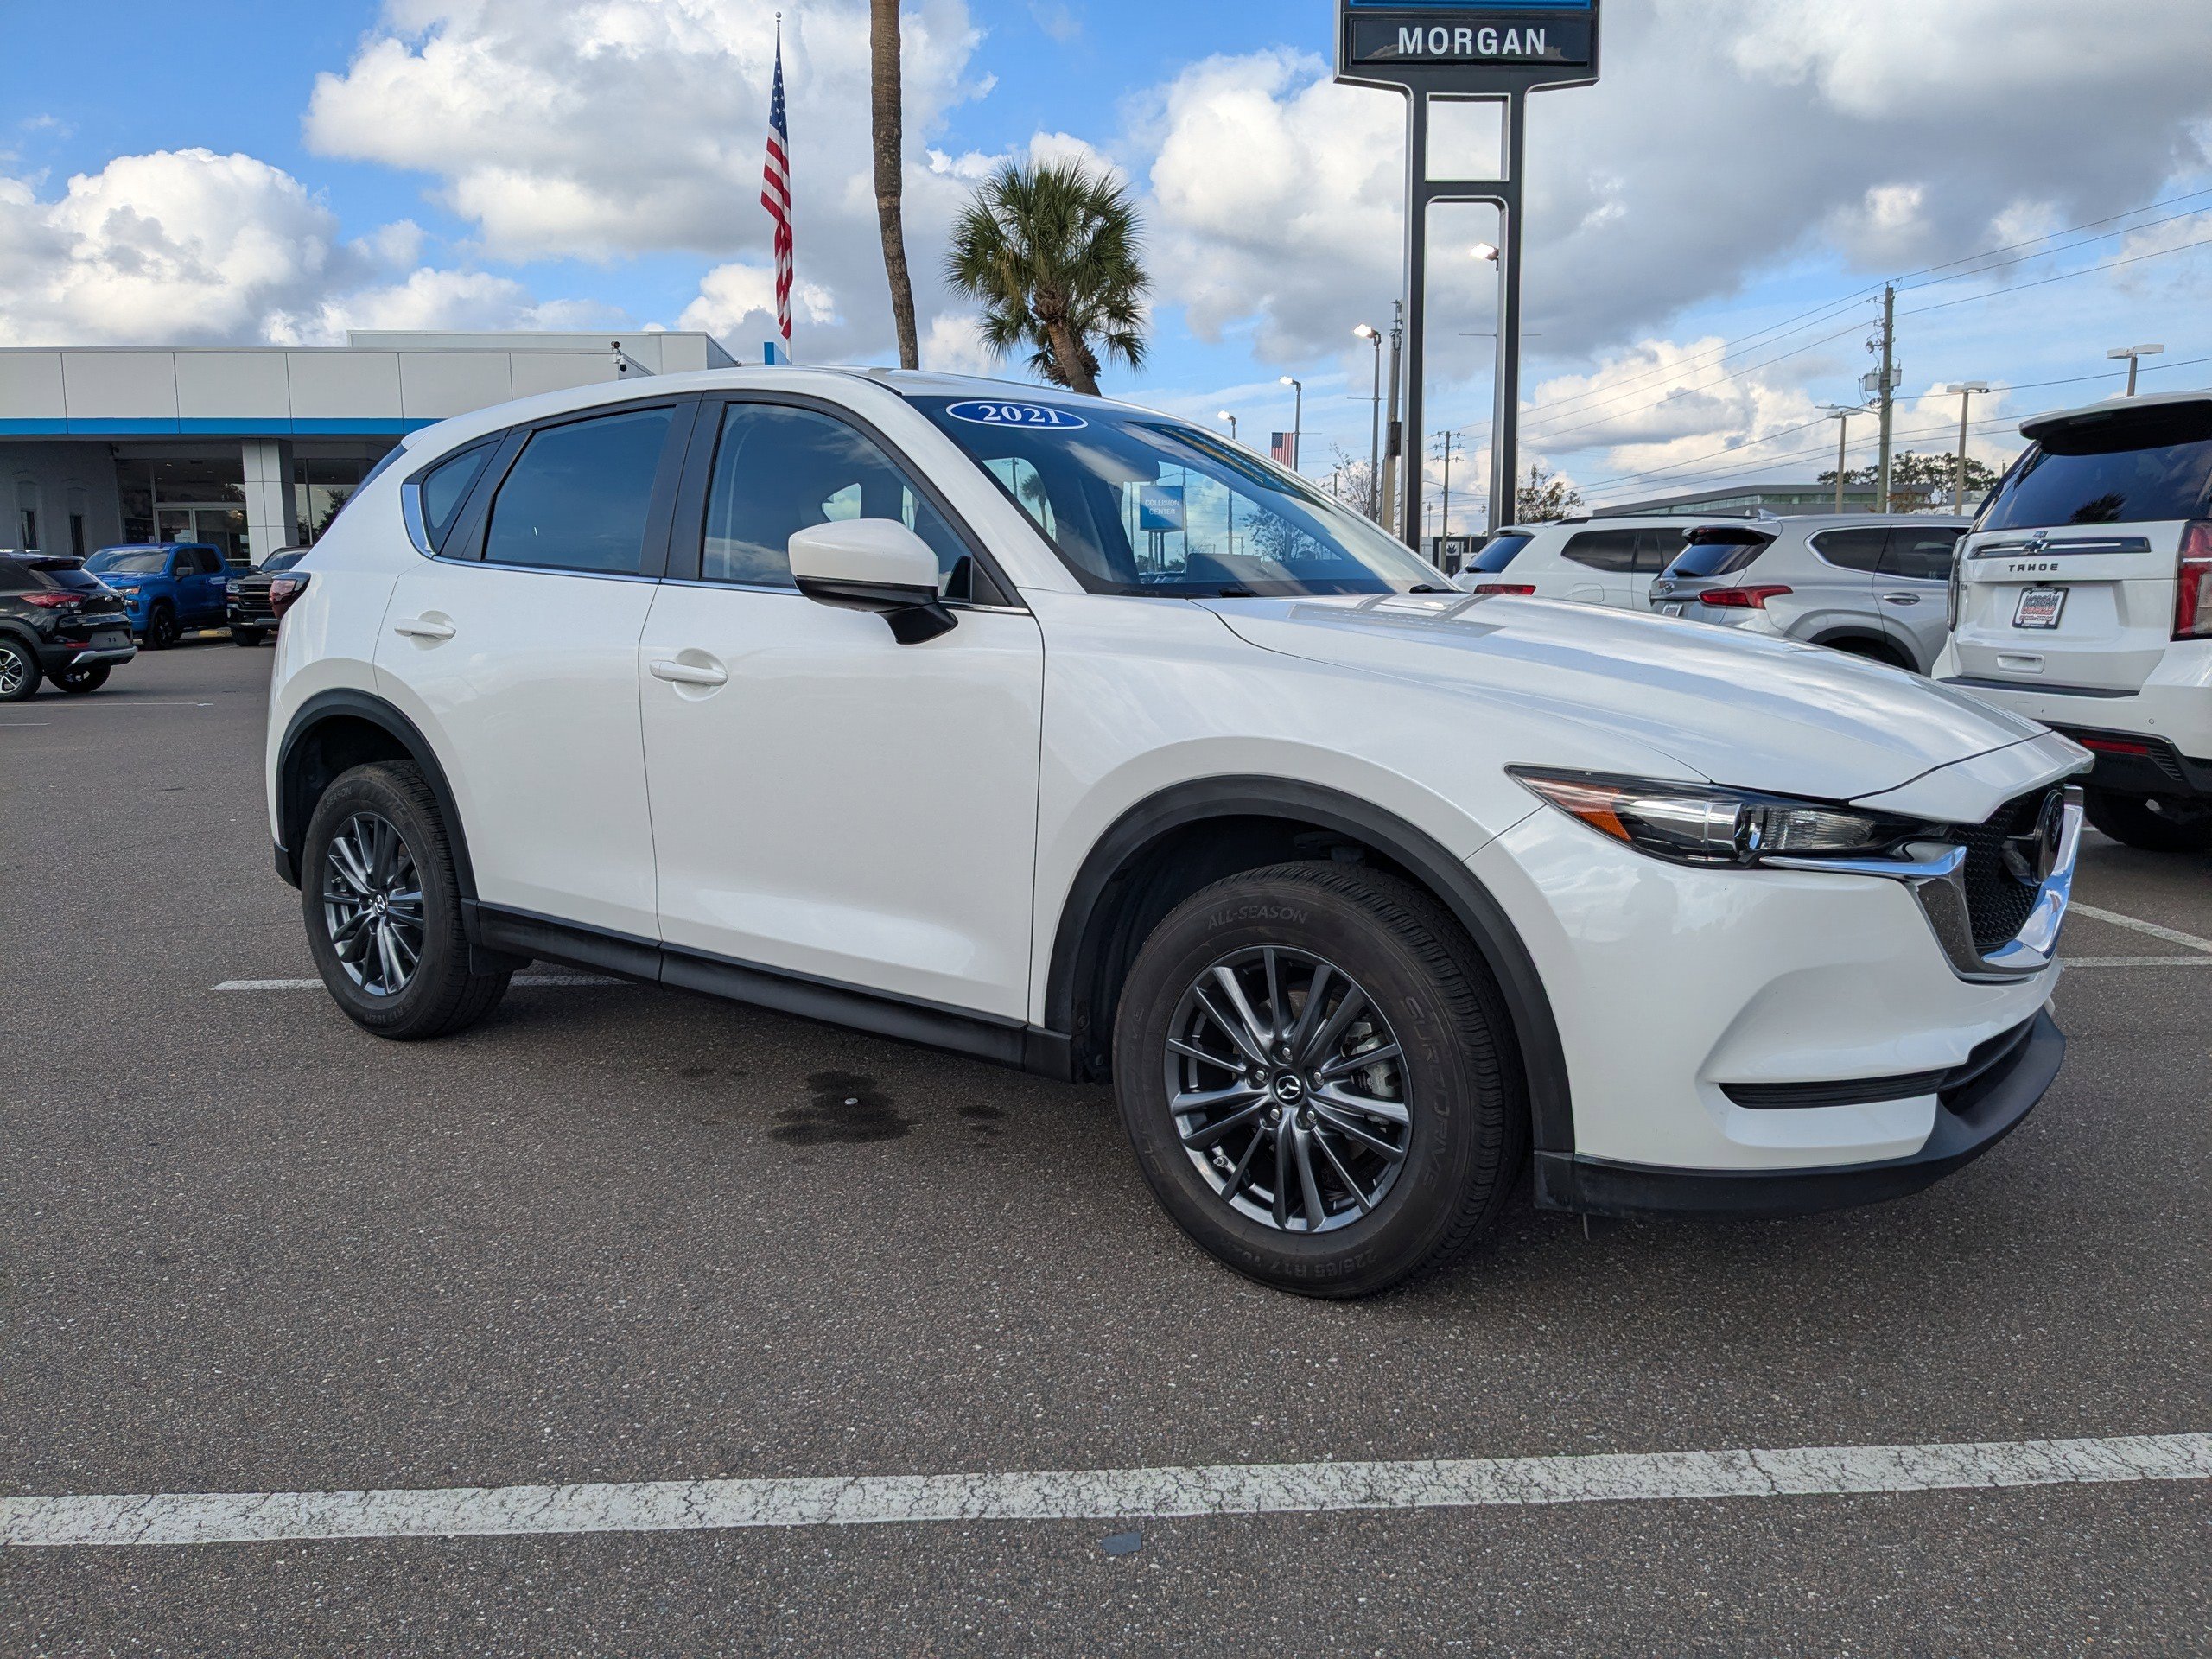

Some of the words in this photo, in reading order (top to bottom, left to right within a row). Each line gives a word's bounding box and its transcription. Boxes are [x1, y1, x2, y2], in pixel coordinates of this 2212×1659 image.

[1398, 27, 1546, 55] MORGAN
[978, 405, 1064, 424] 2021
[2009, 563, 2058, 572] TAHOE
[1208, 905, 1308, 930] ALL-SEASON
